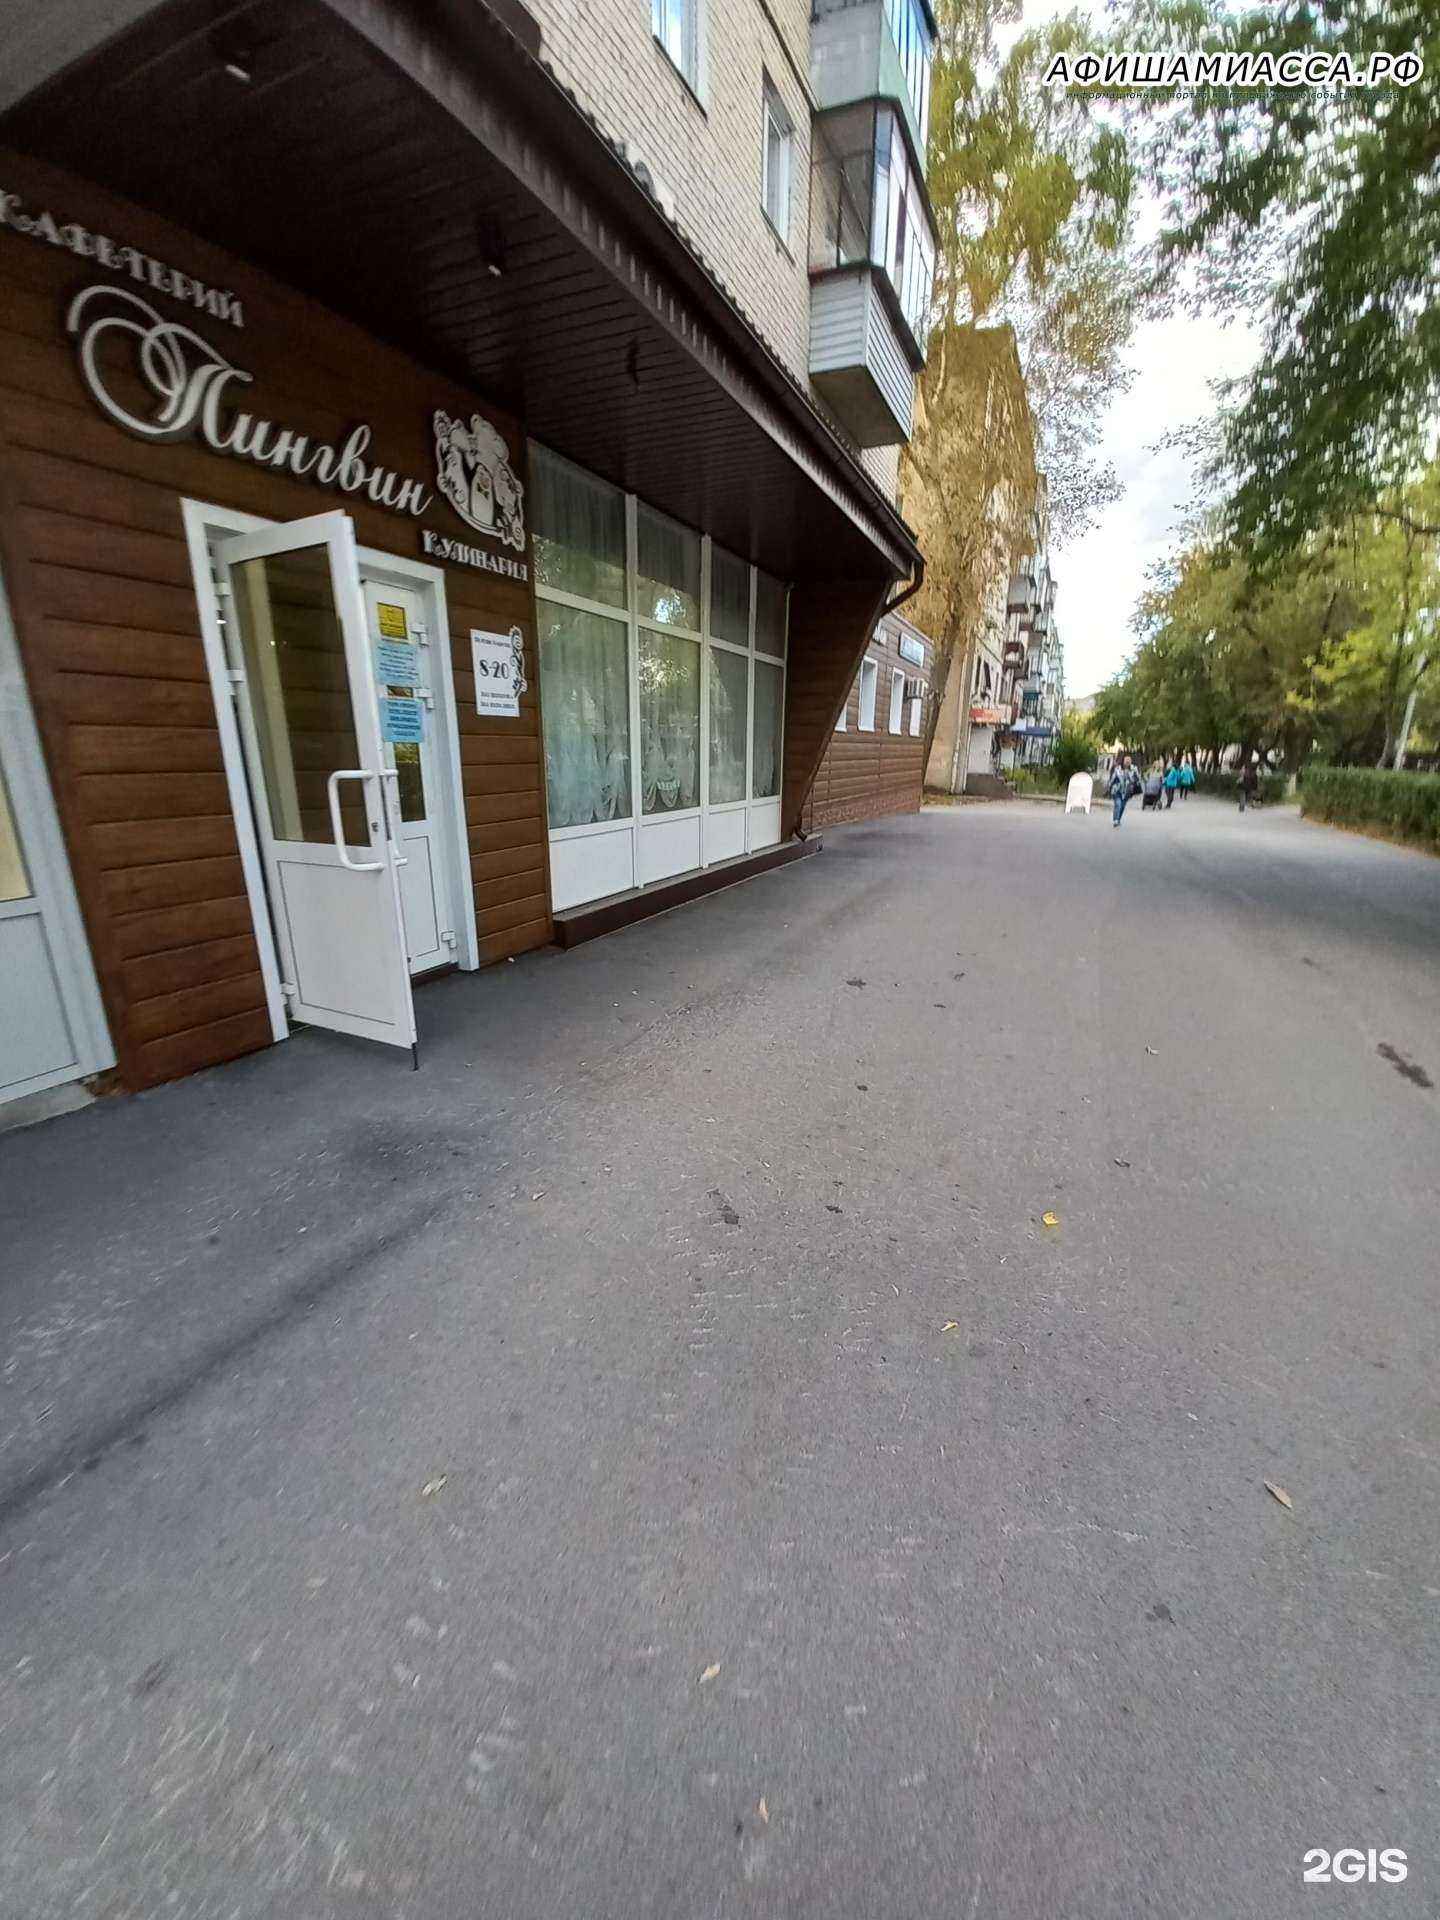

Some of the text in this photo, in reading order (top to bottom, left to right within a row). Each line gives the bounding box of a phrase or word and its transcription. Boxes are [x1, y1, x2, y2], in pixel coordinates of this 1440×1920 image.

[67, 285, 433, 517] Пингвин
[421, 529, 529, 582] КУЛИНАРИЯ
[479, 659, 509, 679] 8-20
